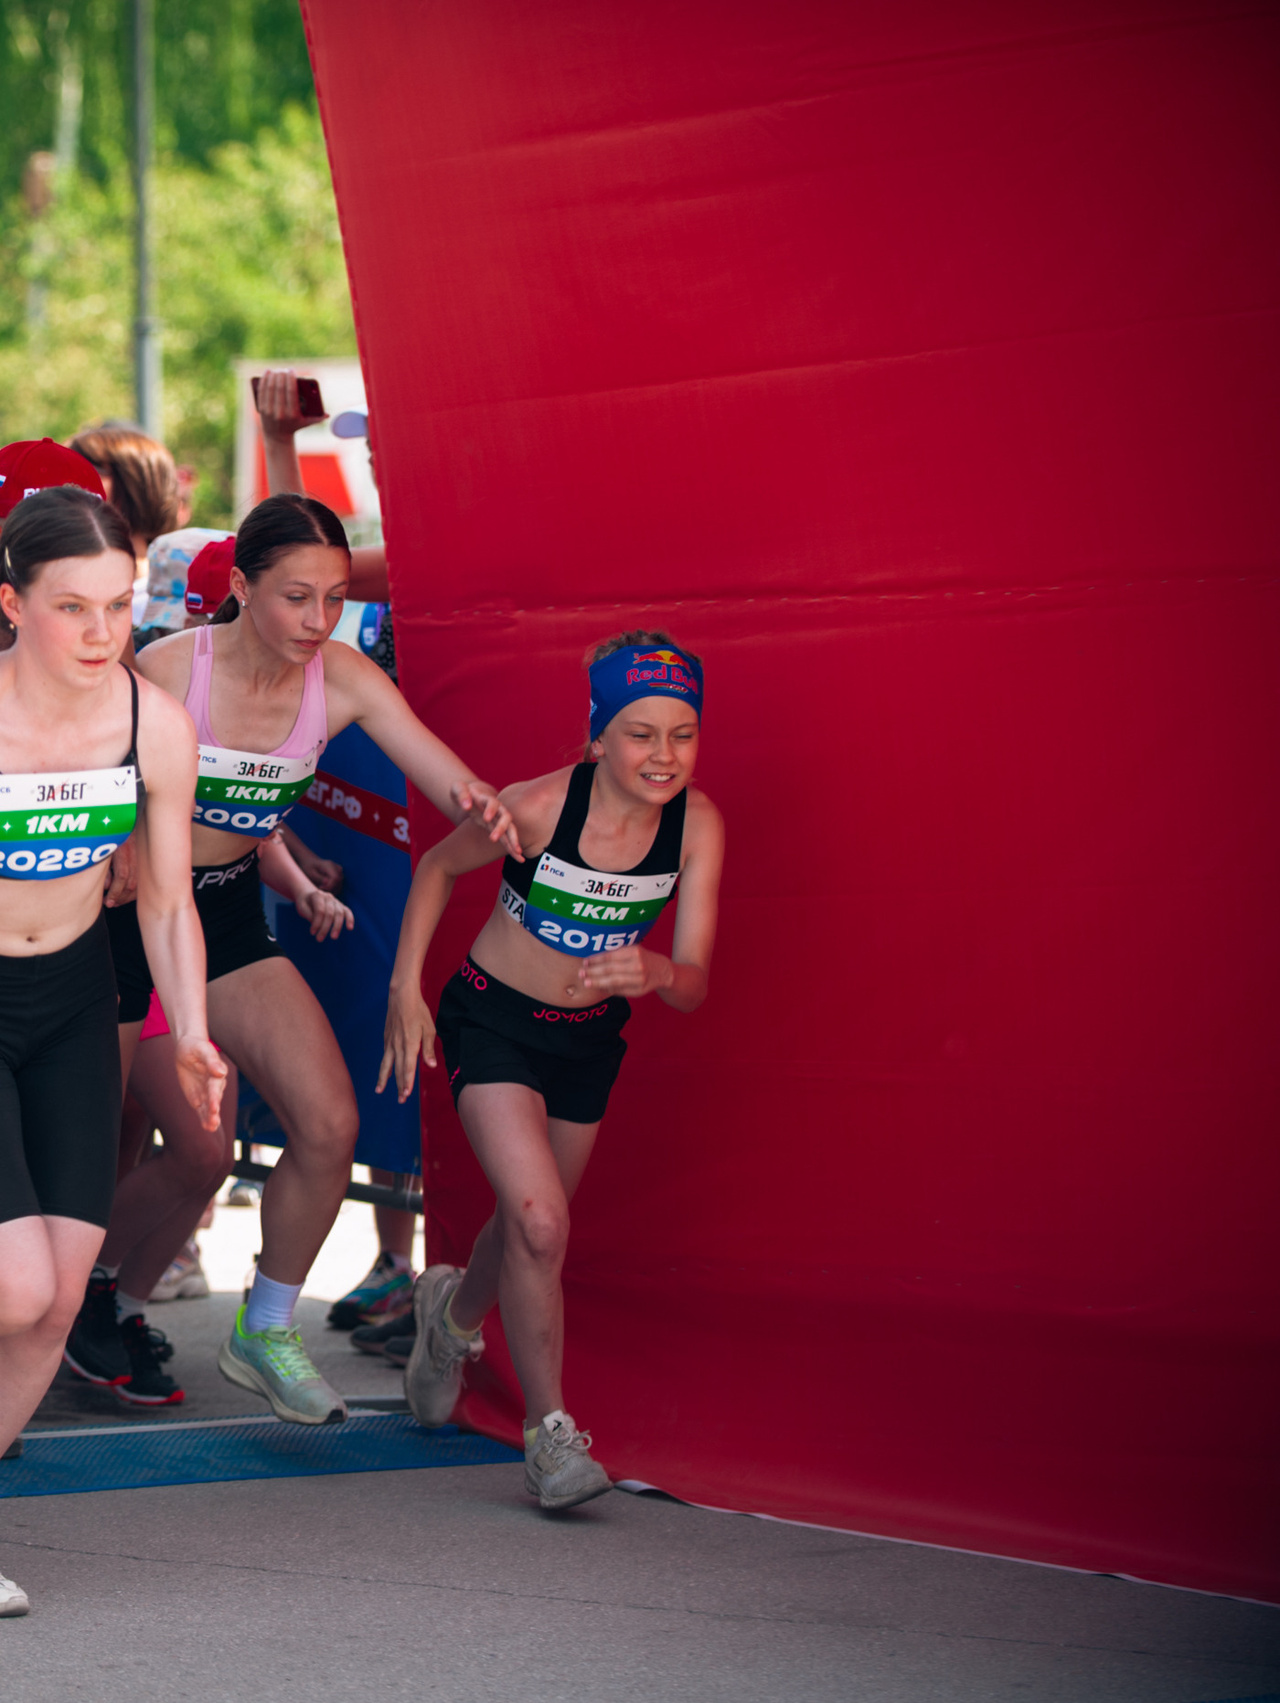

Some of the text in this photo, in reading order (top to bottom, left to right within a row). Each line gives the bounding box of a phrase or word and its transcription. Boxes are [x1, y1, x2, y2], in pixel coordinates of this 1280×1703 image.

[626, 664, 668, 685] Red
[549, 867, 565, 878] ПСБ
[538, 920, 640, 952] 20151
